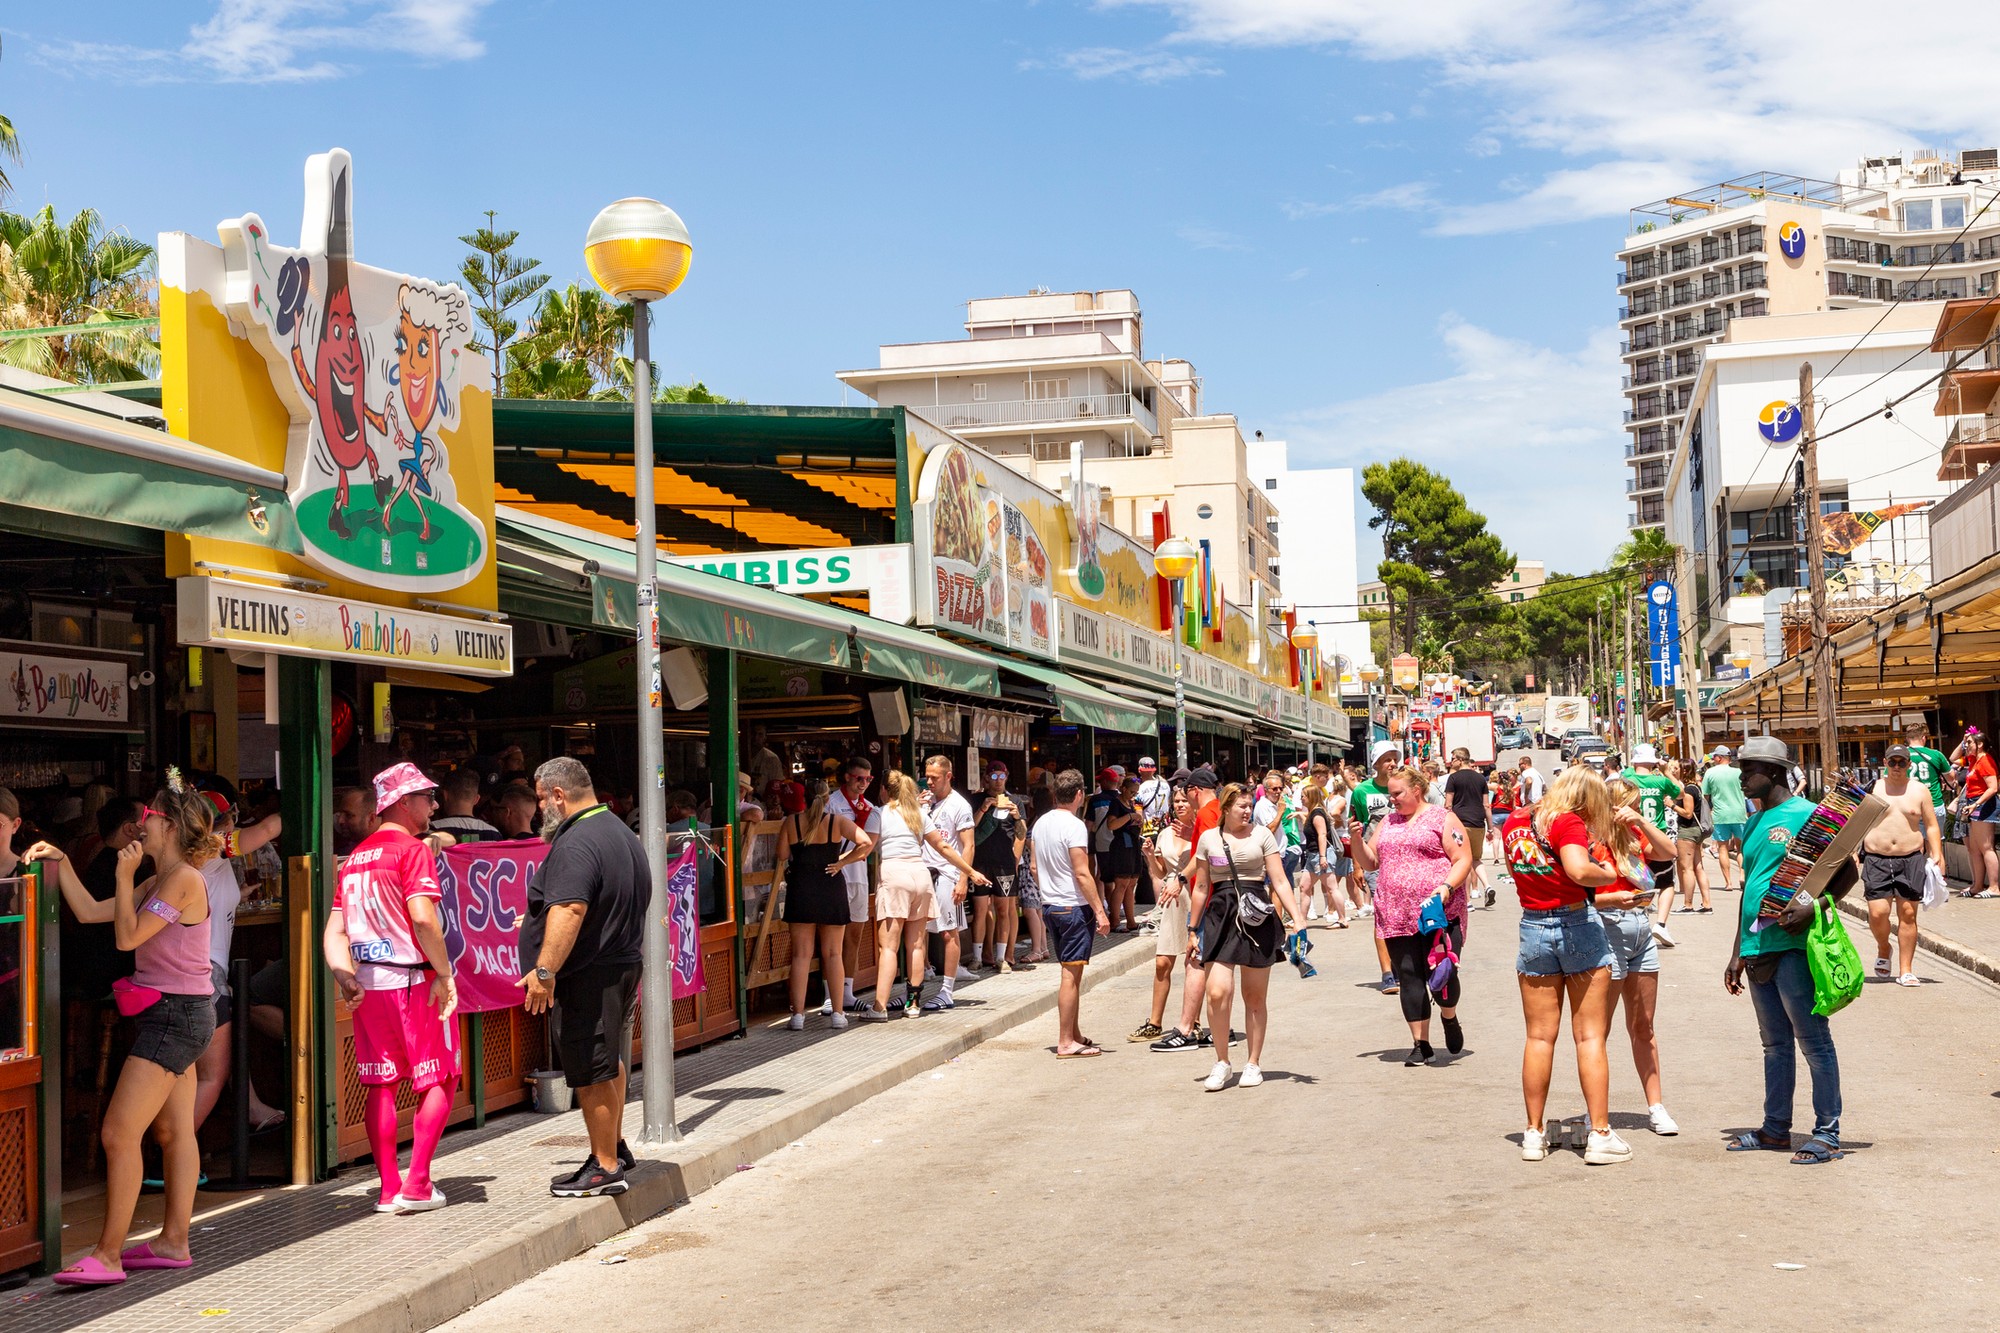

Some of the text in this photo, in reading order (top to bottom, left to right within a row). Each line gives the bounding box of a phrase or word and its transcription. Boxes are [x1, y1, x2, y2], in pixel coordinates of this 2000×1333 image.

[684, 556, 851, 586] MBISS
[936, 565, 986, 633] PIZZA
[216, 596, 506, 661] VELTINS Bamboleo VELTINS
[1073, 611, 1099, 650] VELTINS
[1130, 633, 1151, 666] VELTINS
[29, 664, 108, 717] Bamboleo
[1639, 787, 1661, 796] E2022
[343, 871, 388, 936] 34
[466, 858, 518, 933] SC
[472, 944, 522, 977] MACH
